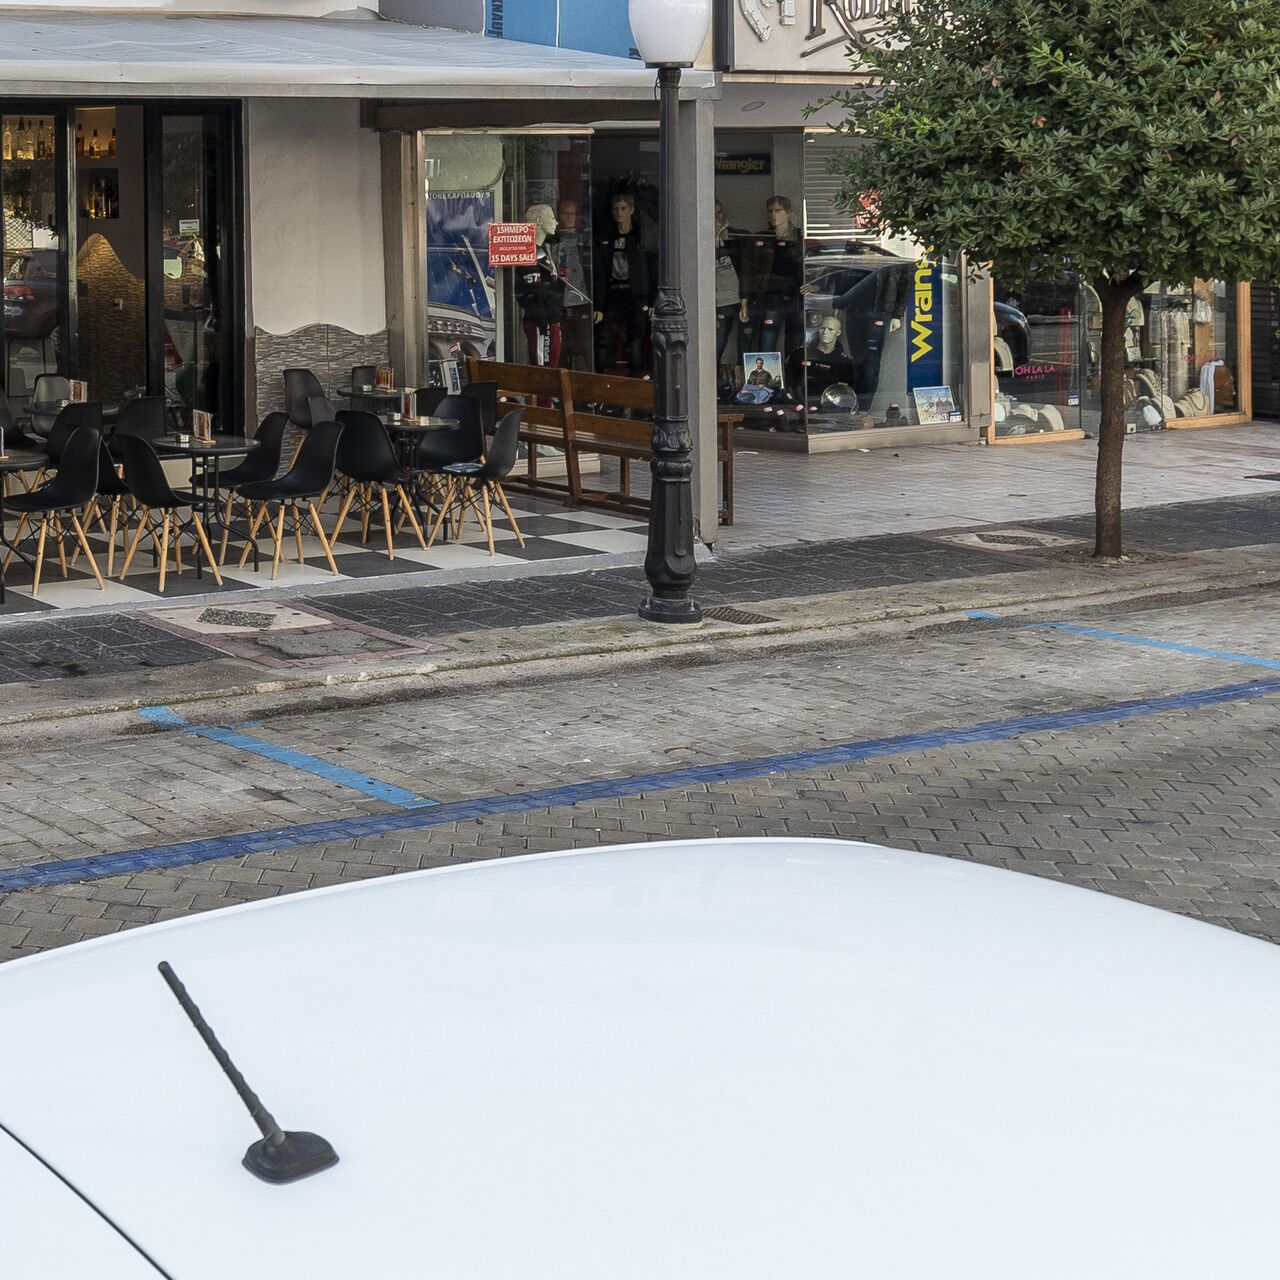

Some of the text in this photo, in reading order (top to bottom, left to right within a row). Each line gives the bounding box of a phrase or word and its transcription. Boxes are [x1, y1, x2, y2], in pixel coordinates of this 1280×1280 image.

[501, 254, 518, 262] DAYS
[519, 253, 534, 261] SALE
[1015, 365, 1056, 375] OH LA LA
